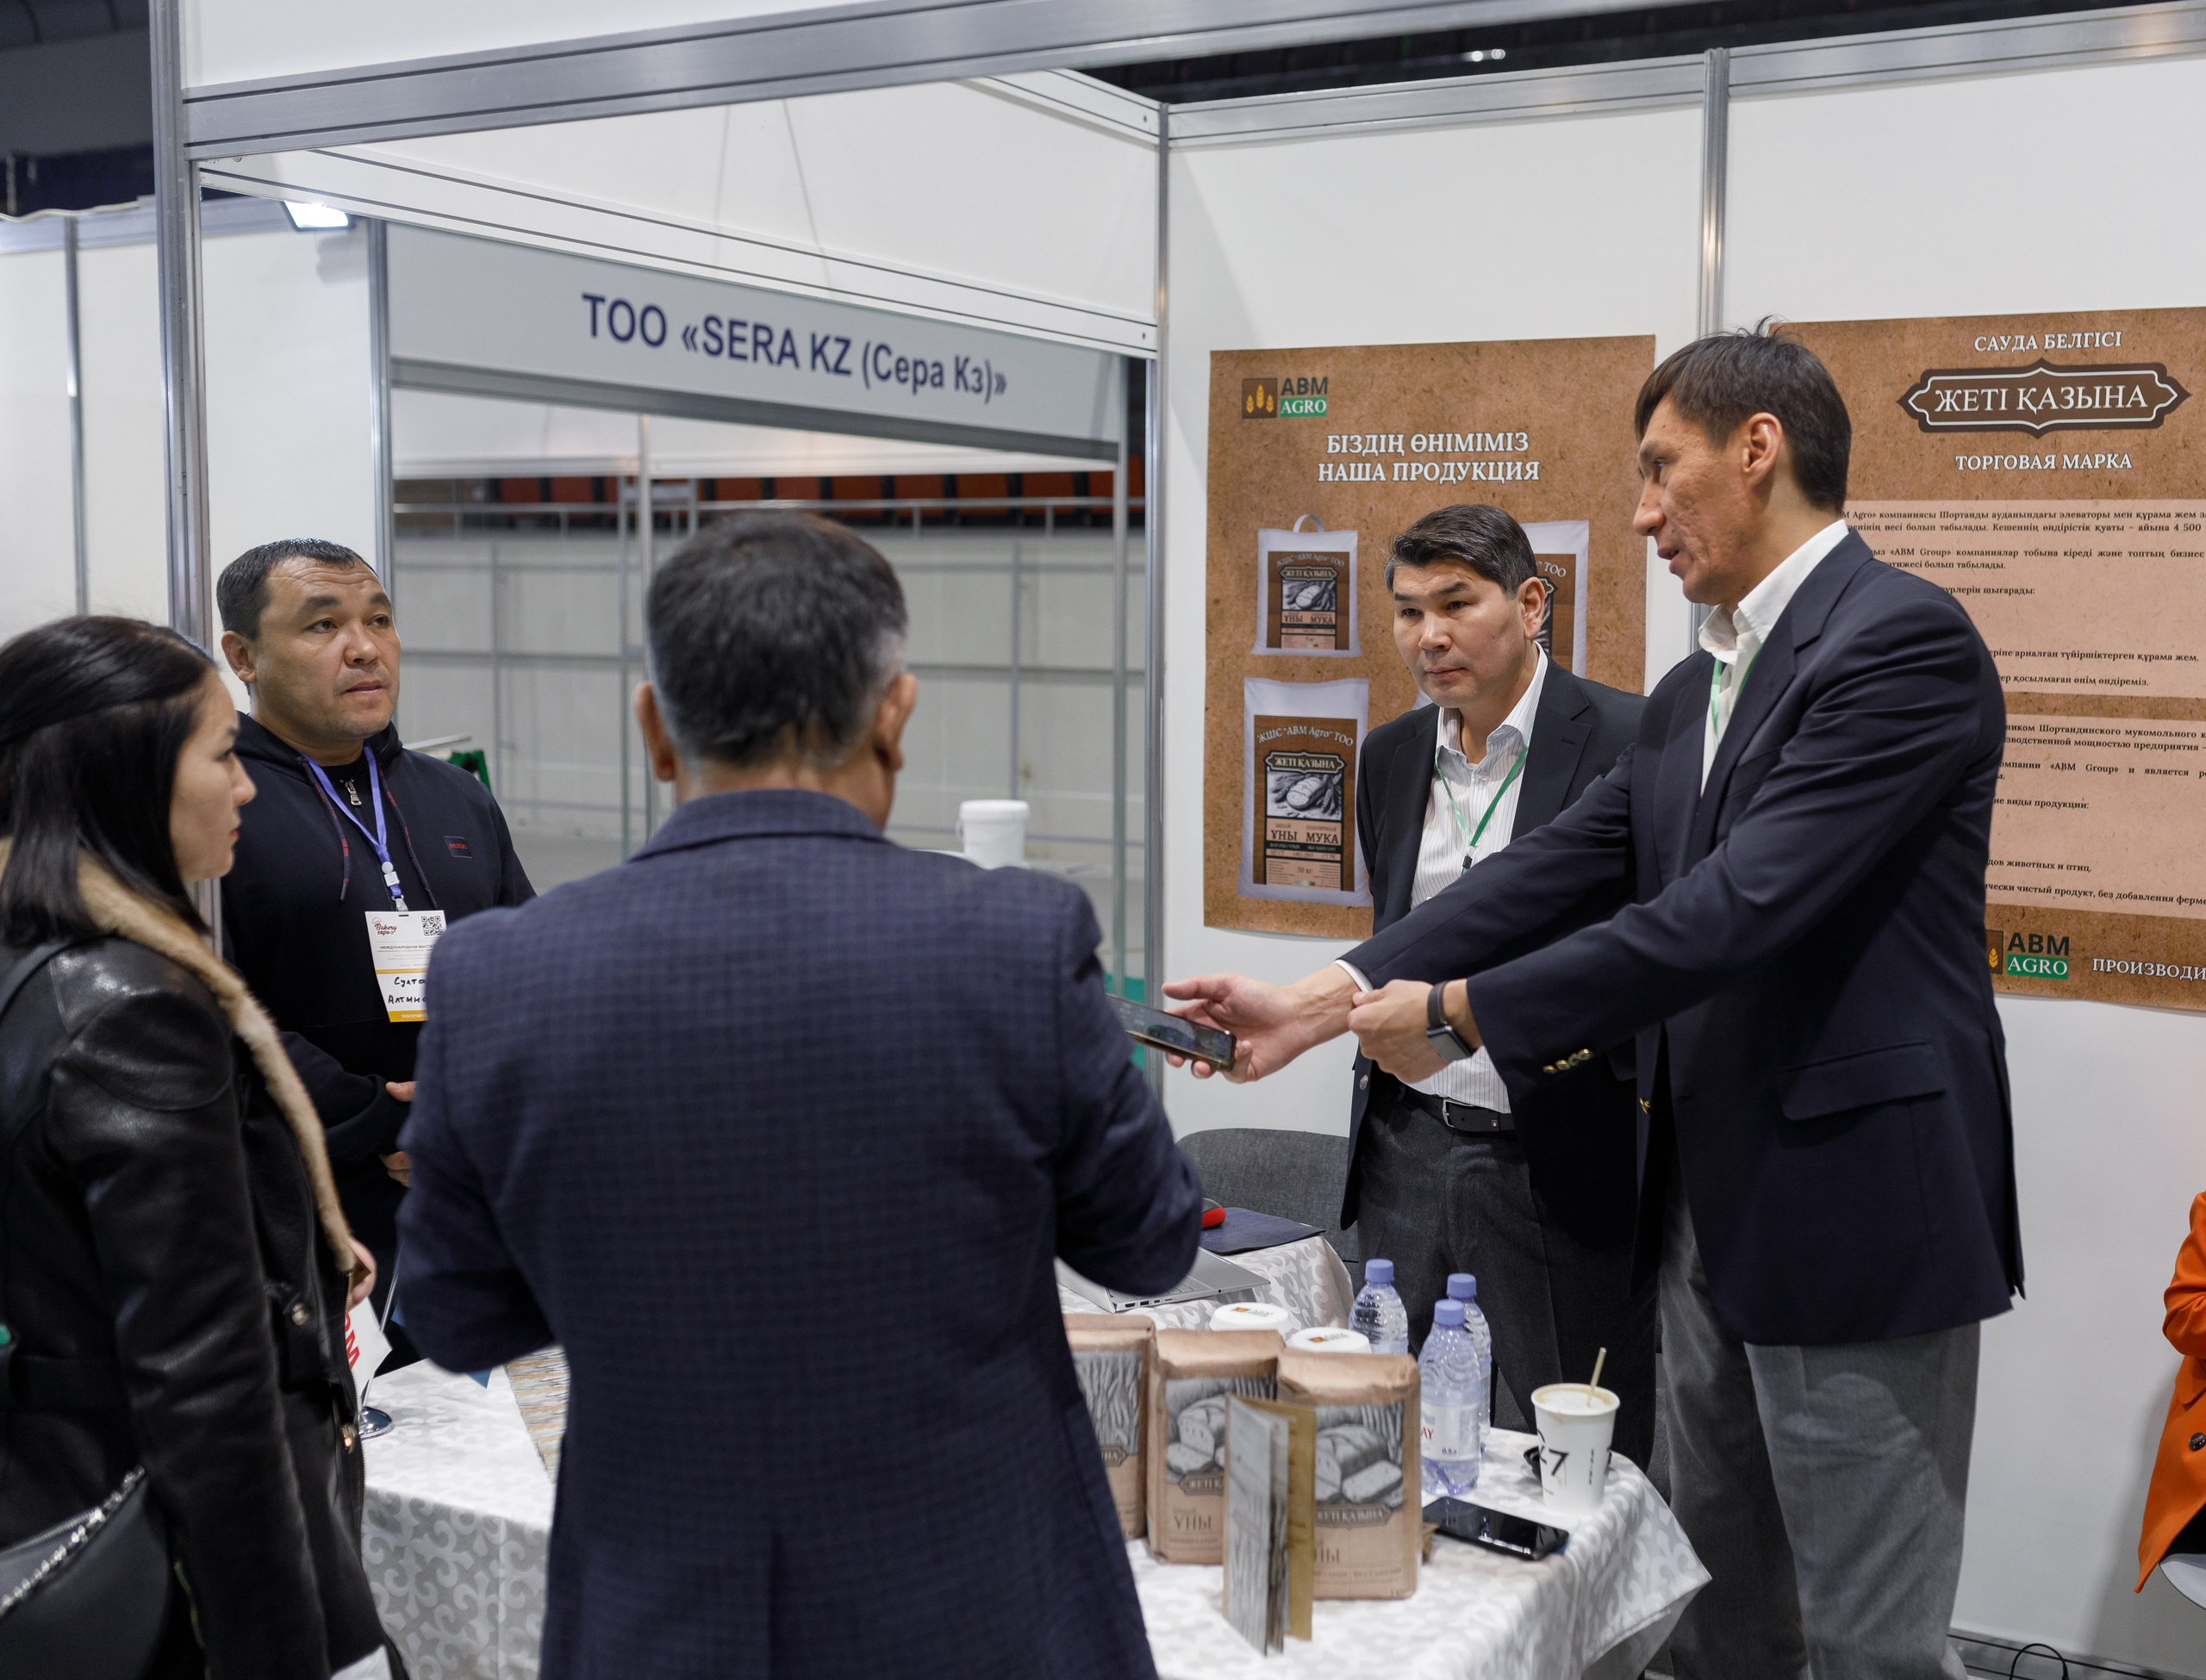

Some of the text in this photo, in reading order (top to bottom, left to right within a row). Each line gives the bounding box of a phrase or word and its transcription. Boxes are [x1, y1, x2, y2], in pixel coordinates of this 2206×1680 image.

[582, 293, 1006, 404] ТОО «SERA KZ (Сера Кз)»
[1974, 331, 2122, 354] САУДА БЕЛГІСІ
[1281, 376, 1329, 396] ABM
[1281, 399, 1327, 414] AGRO
[1935, 384, 2148, 415] ЖЕТІ ҚАЗЫНА
[1326, 432, 1530, 456] БІЗДІҢ ӨНІМІМІЗ
[1955, 452, 2133, 471] ТОРГОВАЯ МАРКА
[1318, 461, 1541, 486] НАША ПРОДУКЦИЯ
[1906, 523, 1935, 532] болып
[2183, 523, 2202, 532] 500
[2171, 550, 2204, 558] бизнес
[1544, 561, 1567, 578] ТОО
[1924, 560, 1954, 569] болып
[1335, 732, 1354, 747] ТОО
[2125, 729, 2197, 738] мукомольного
[2074, 739, 2131, 749] мощностью
[2134, 742, 2199, 751] предприятия
[1274, 756, 1297, 767] ЖЕТІ
[2035, 800, 2089, 810] продукции:
[1306, 832, 1339, 844] МУКА
[2006, 859, 2055, 869] животных
[2016, 885, 2052, 894] чистый
[2054, 887, 2096, 899] продукт,
[2098, 889, 2114, 899] без
[2116, 891, 2173, 903] добавления
[2176, 893, 2206, 905] ферме
[2007, 932, 2070, 956] ABM
[2008, 957, 2068, 976] AGRO
[2092, 957, 2206, 982] ПРОИЗВОДИ
